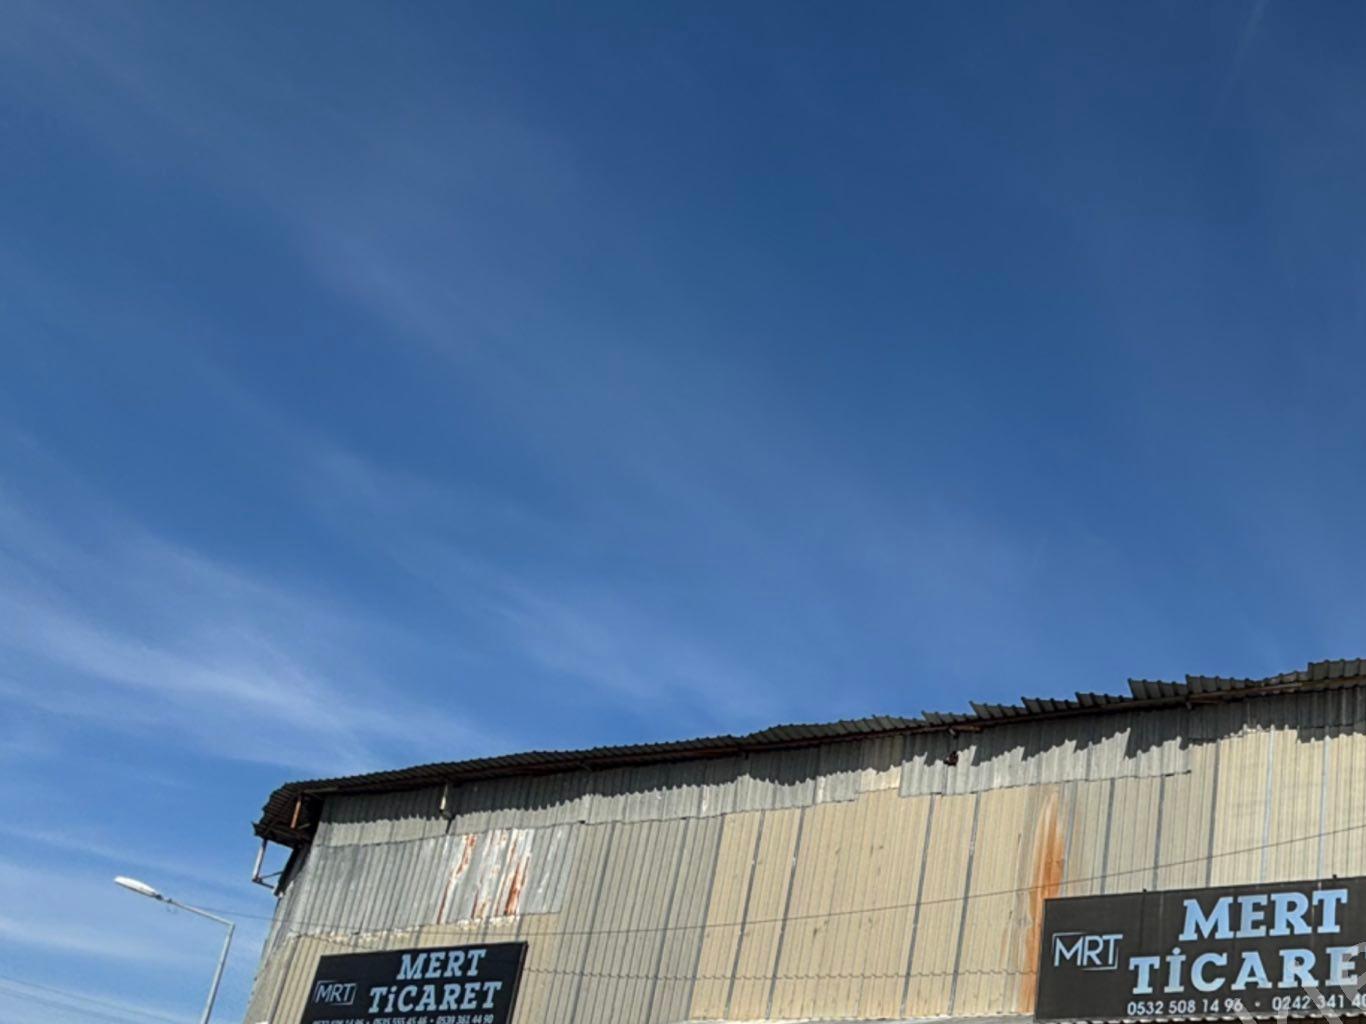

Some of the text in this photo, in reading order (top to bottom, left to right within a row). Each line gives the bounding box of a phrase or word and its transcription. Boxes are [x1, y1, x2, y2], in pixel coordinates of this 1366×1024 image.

[1178, 888, 1348, 942] MERT
[396, 949, 487, 980] MERT
[1053, 934, 1123, 968] MRT
[314, 983, 357, 1003] MRT
[1127, 1001, 1164, 1016] 0532
[1168, 1000, 1196, 1014] 508
[1202, 999, 1219, 1012] 14
[1224, 998, 1243, 1012] 96
[1272, 995, 1311, 1011] 0242
[1317, 994, 1344, 1009] 341
